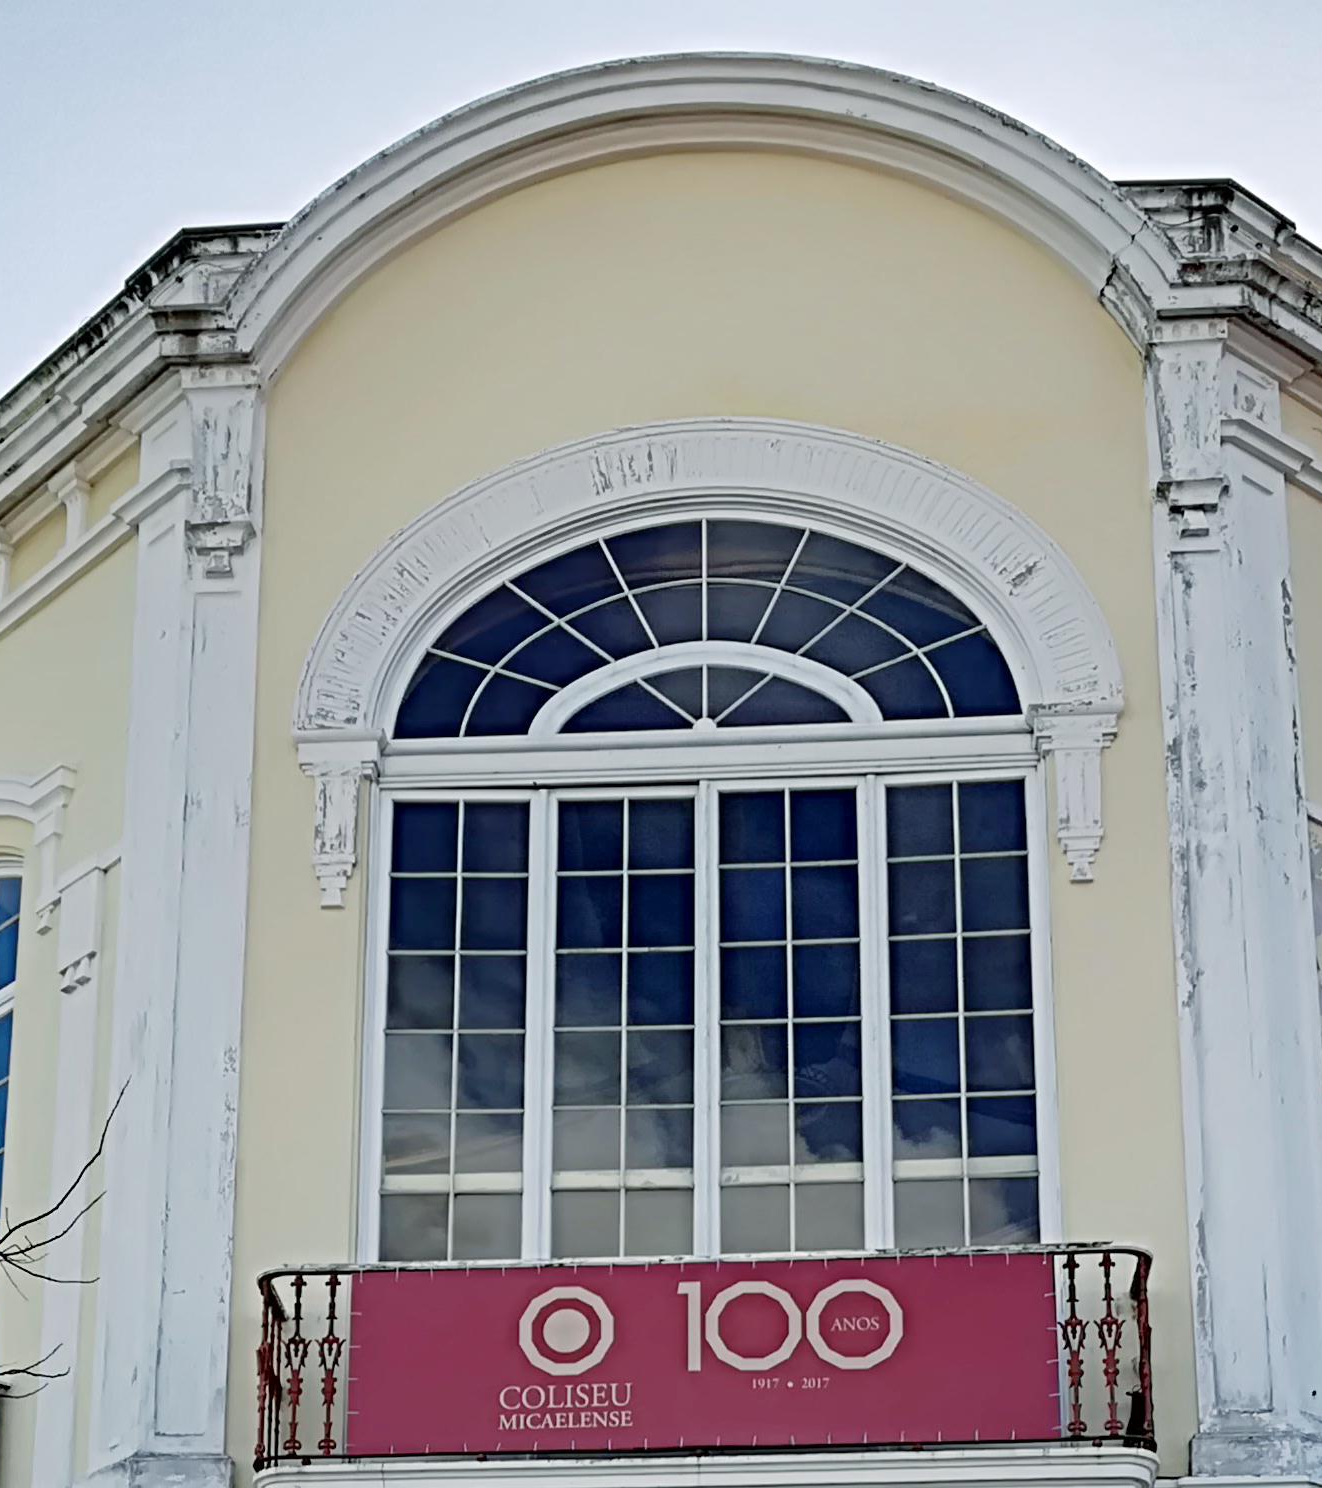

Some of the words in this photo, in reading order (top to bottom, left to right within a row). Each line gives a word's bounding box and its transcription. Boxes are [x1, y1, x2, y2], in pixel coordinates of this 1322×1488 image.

[677, 1279, 904, 1372] 100
[830, 1314, 880, 1333] ANOS
[751, 1377, 780, 1390] 1917
[801, 1376, 830, 1390] 2017
[498, 1382, 634, 1411] COLISEU
[498, 1410, 634, 1431] MICAELENSE
